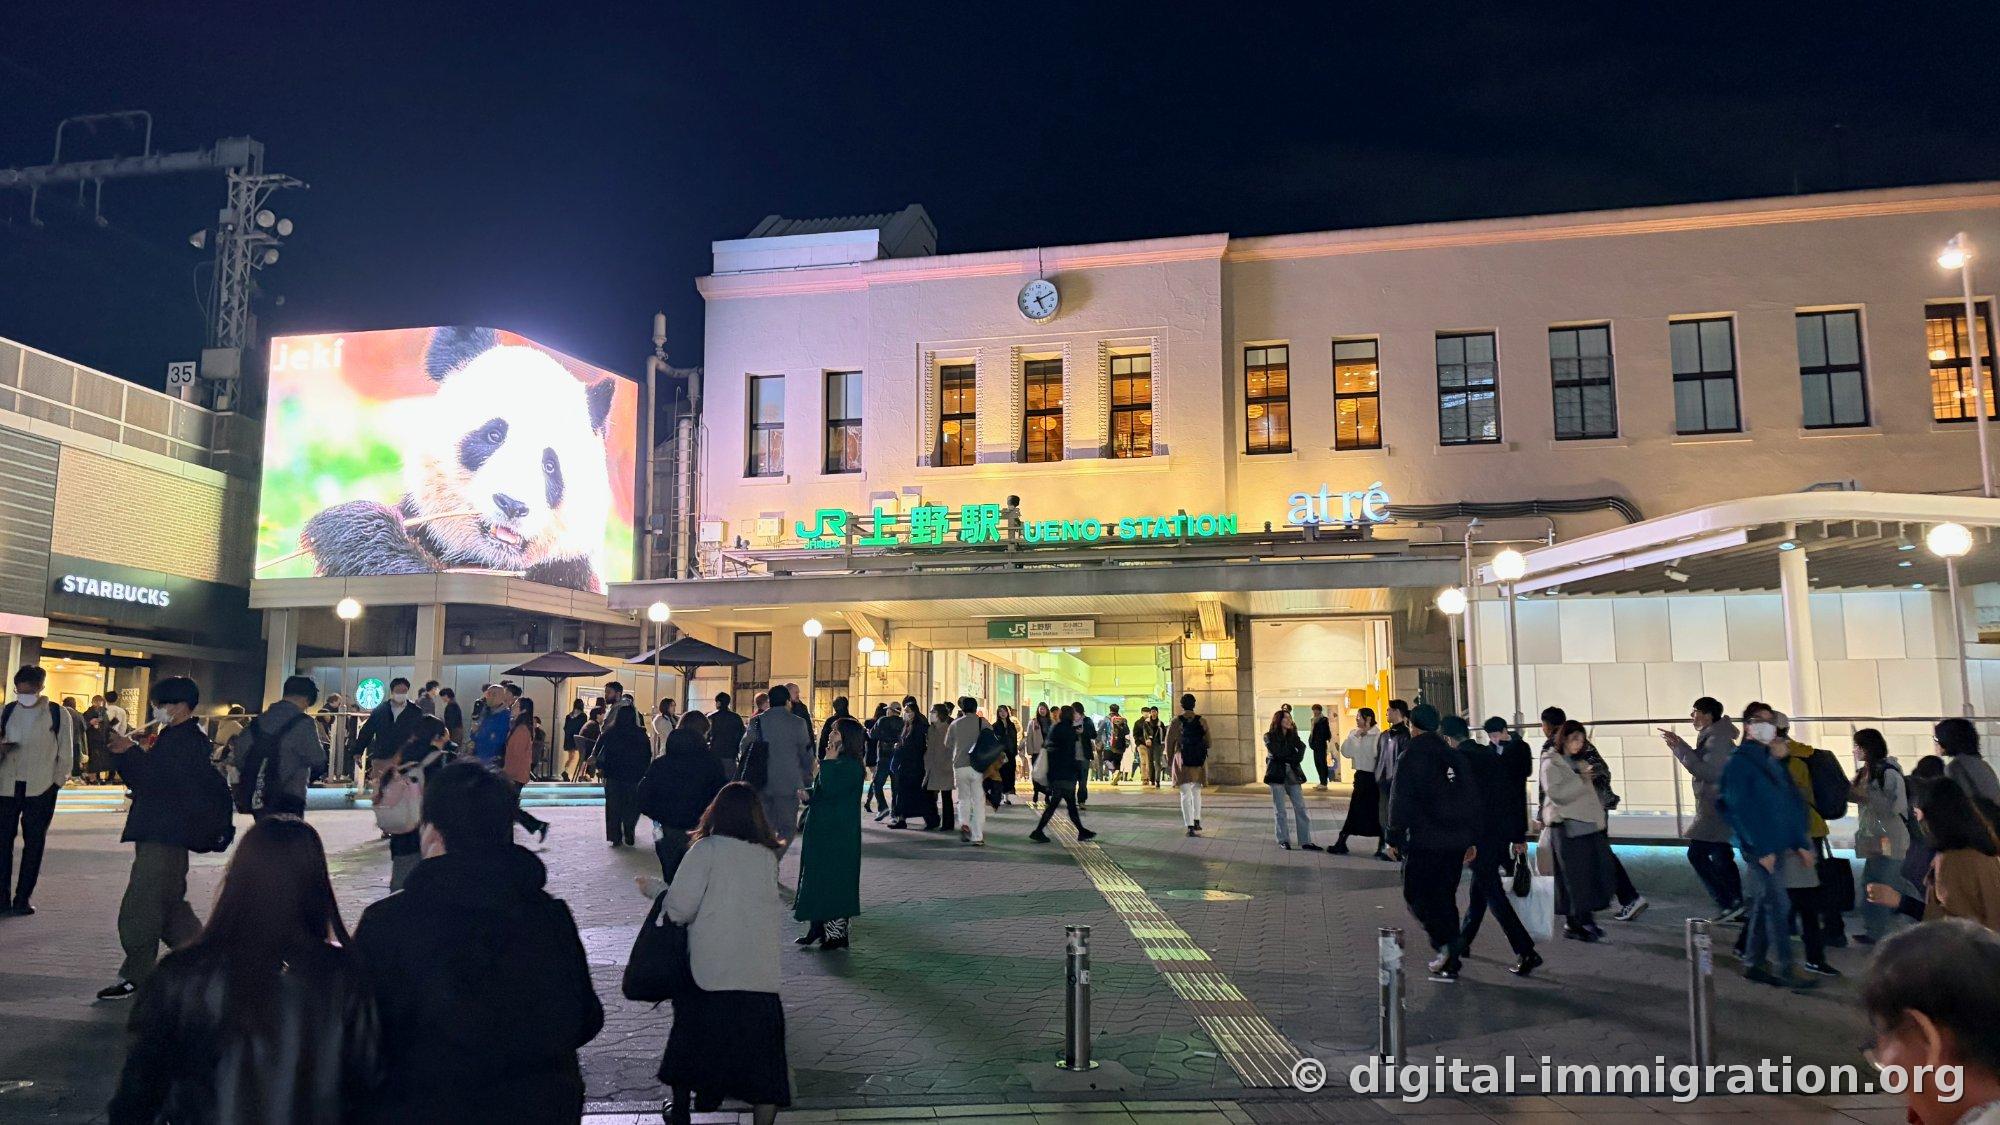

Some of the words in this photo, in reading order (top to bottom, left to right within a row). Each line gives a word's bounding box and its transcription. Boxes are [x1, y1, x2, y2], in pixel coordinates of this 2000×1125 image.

[273, 337, 345, 371] jeki
[170, 365, 192, 383] 35
[1287, 481, 1391, 525] atré
[795, 508, 847, 539] JR
[859, 503, 1001, 546] 上野駅
[1024, 518, 1102, 543] UENO
[1119, 513, 1238, 540] STATION
[63, 574, 170, 607] STARBUCKS
[1009, 624, 1026, 634] JR
